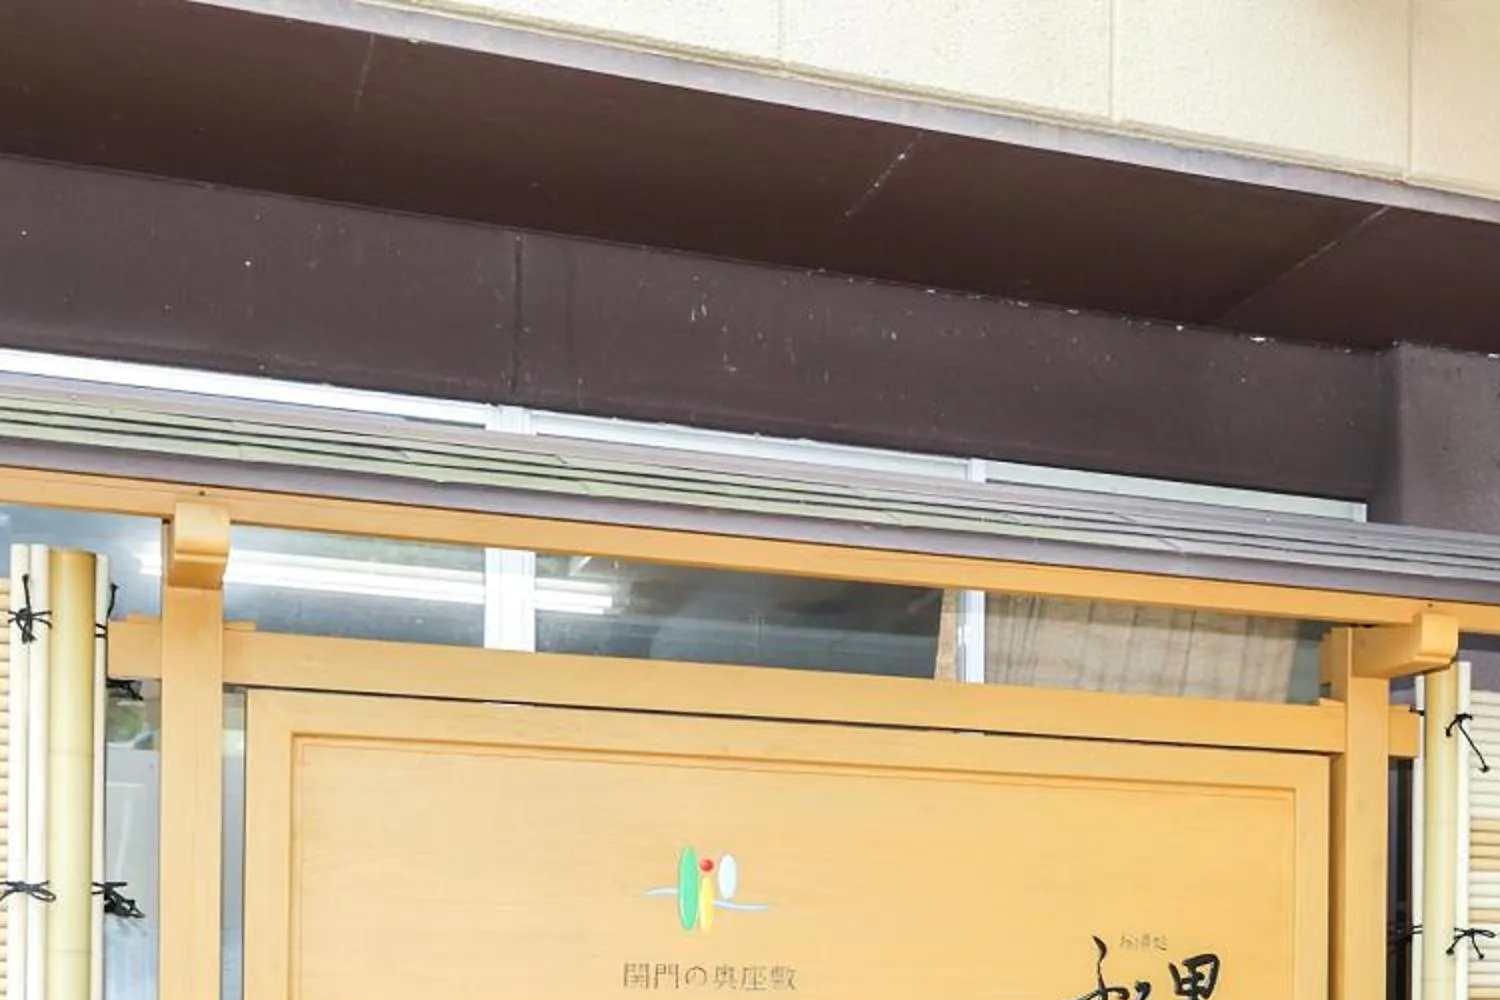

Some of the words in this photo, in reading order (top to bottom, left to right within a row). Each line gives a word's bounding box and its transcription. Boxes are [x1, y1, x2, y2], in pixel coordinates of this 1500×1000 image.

[623, 962, 797, 990] 関門の奥座敷
